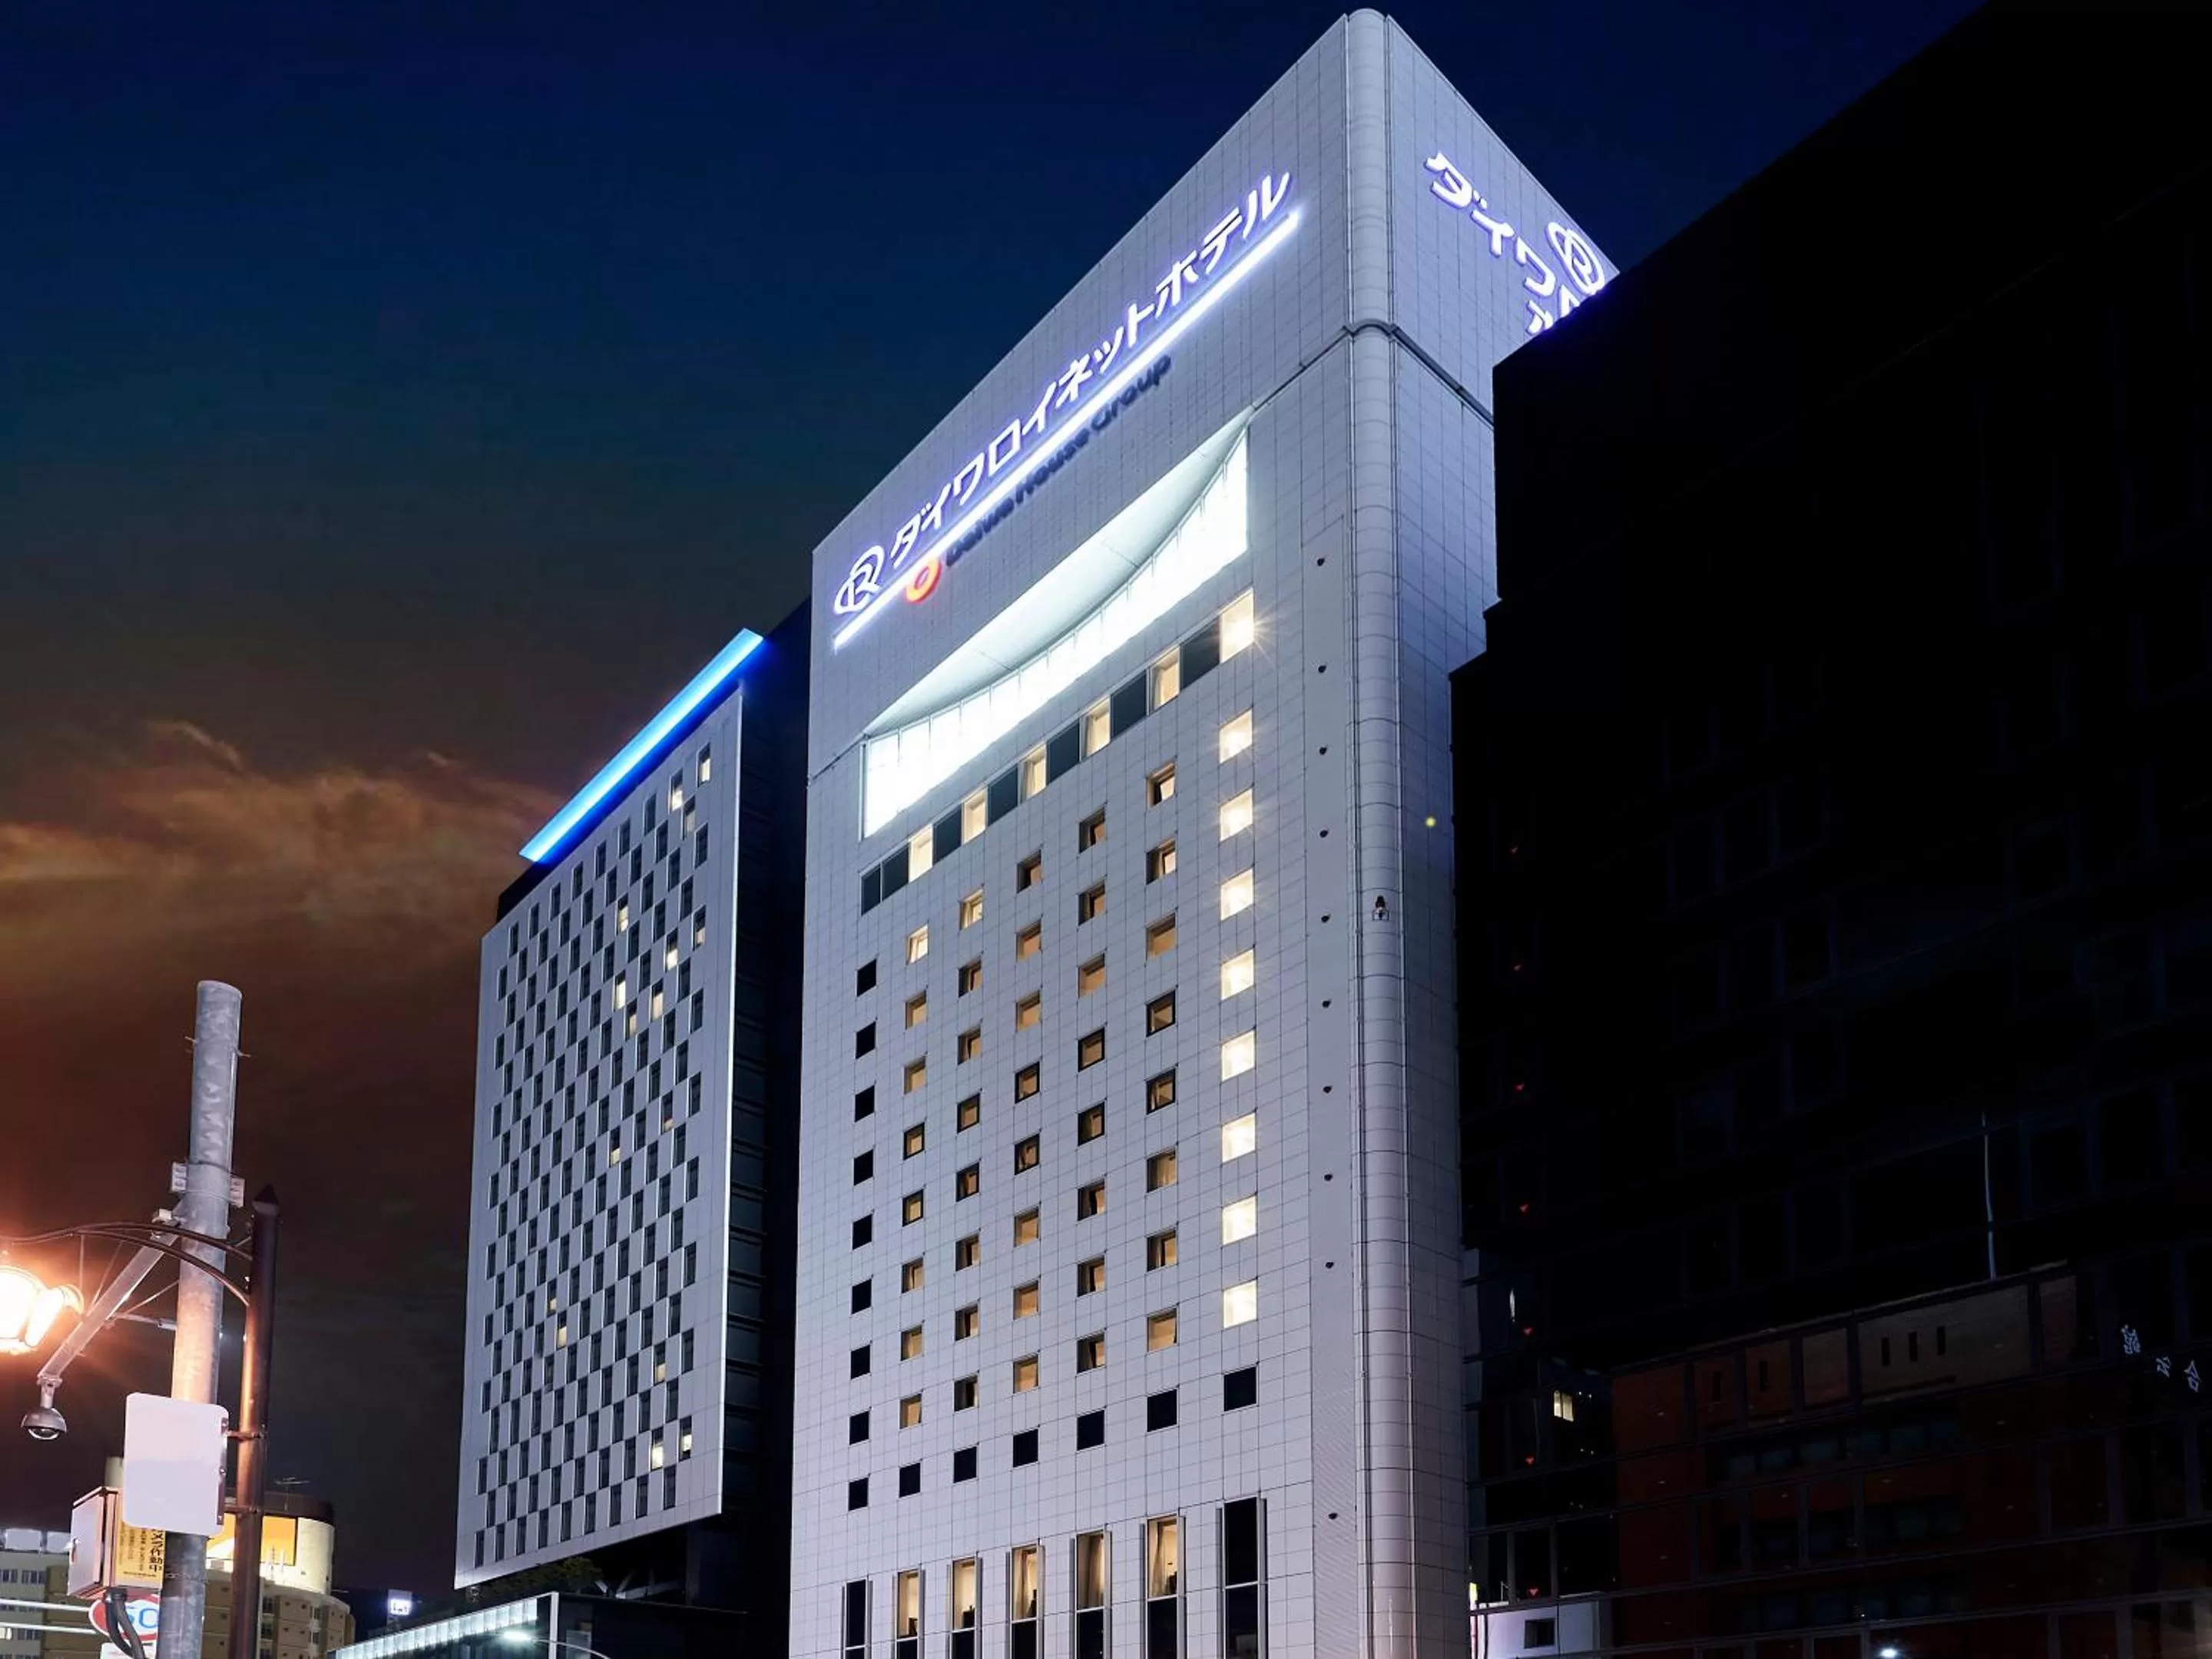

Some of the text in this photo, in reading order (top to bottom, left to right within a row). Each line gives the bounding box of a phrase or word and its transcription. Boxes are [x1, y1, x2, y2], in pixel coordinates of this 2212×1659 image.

[890, 171, 1290, 567] ダイワロイネットホテル
[1091, 354, 1172, 432] Group
